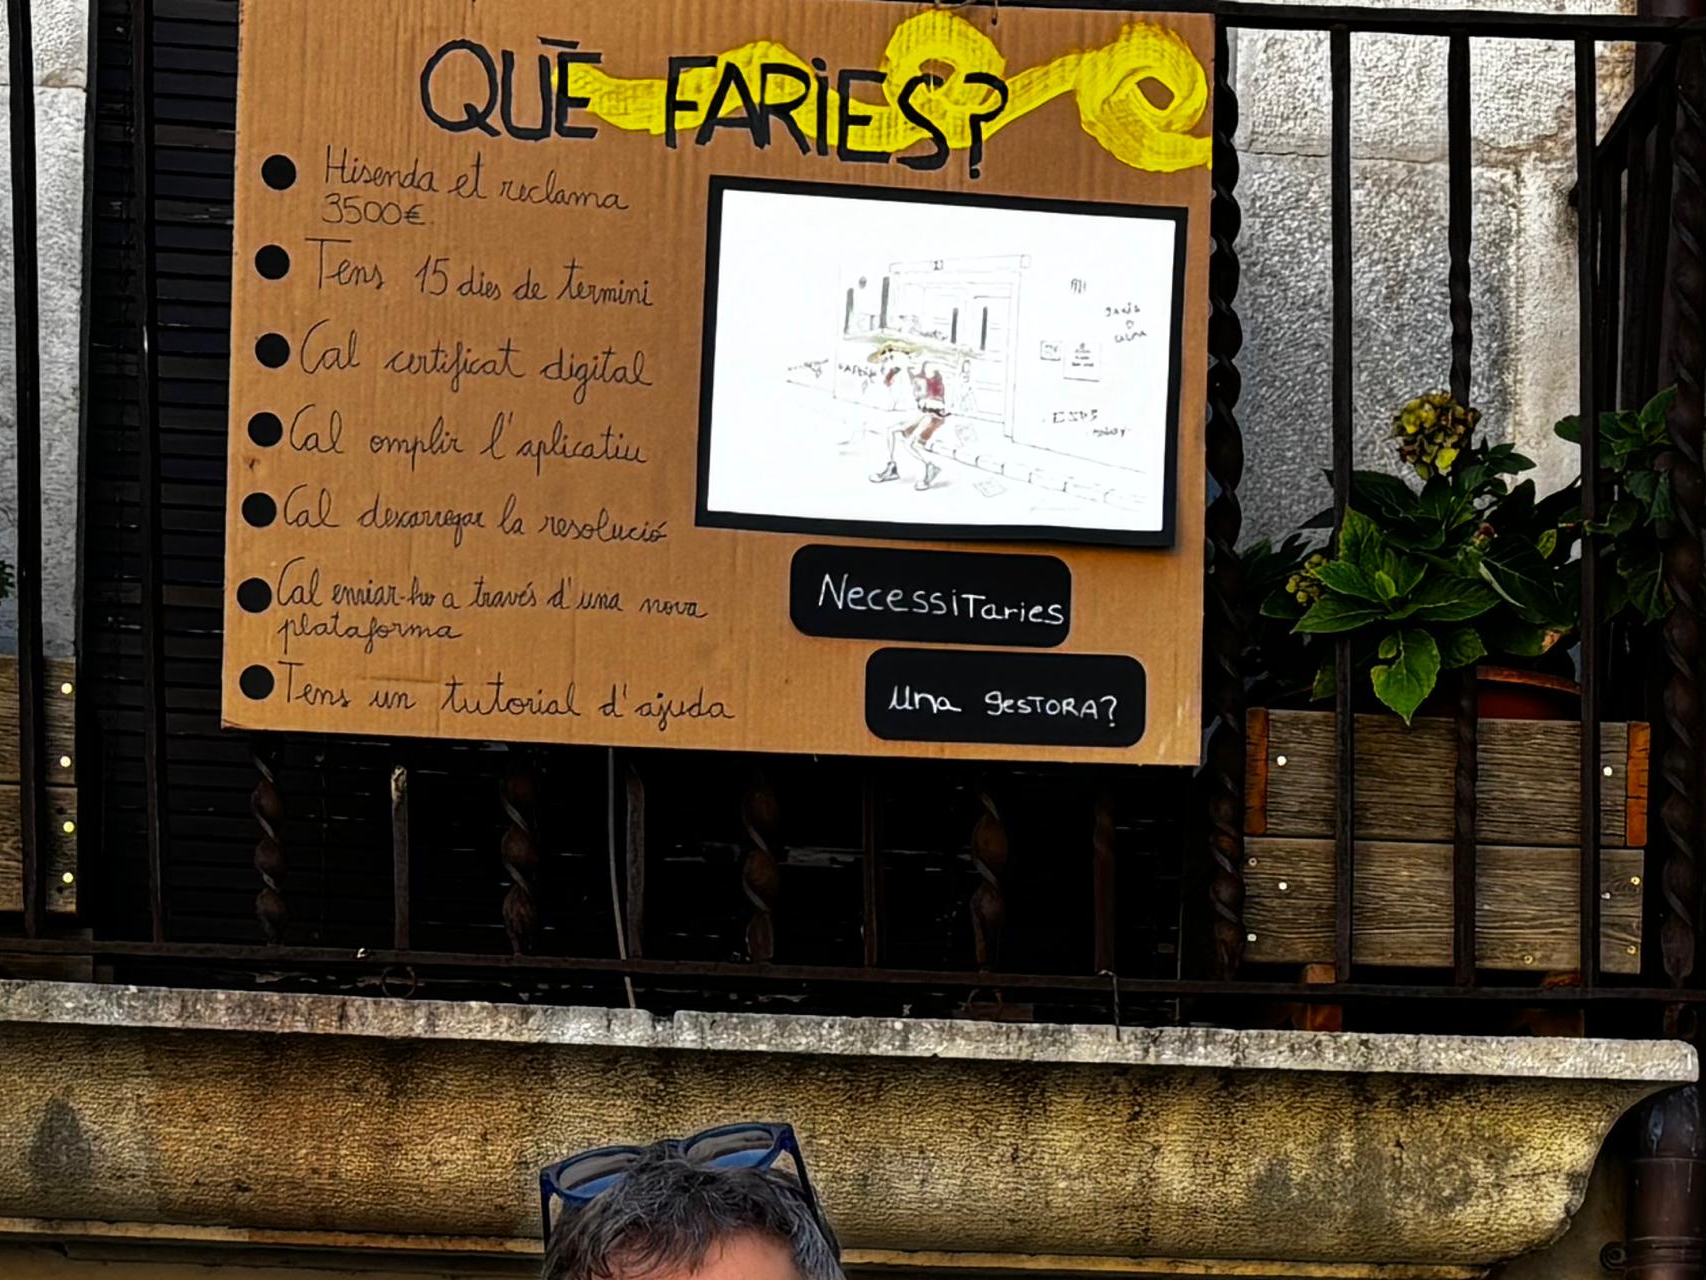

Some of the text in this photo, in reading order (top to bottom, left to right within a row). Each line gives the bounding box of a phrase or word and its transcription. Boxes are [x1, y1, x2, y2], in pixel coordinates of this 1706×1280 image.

[324, 145, 629, 210] Hisenda et reclama
[305, 237, 653, 306] Tens 15 dies de termini
[300, 318, 653, 404] Cal certificat digital
[290, 403, 344, 454] Cal
[369, 415, 463, 472] omplir
[284, 484, 339, 529] Cal
[498, 495, 525, 535] la
[539, 509, 668, 543] resolució
[276, 557, 323, 608] Cal
[442, 592, 462, 610] a
[468, 576, 537, 609] través
[547, 578, 623, 612] d'una
[639, 597, 709, 619] nova
[277, 613, 463, 654] plataforma
[278, 661, 735, 732] Tens un tutorial d'ajuda
